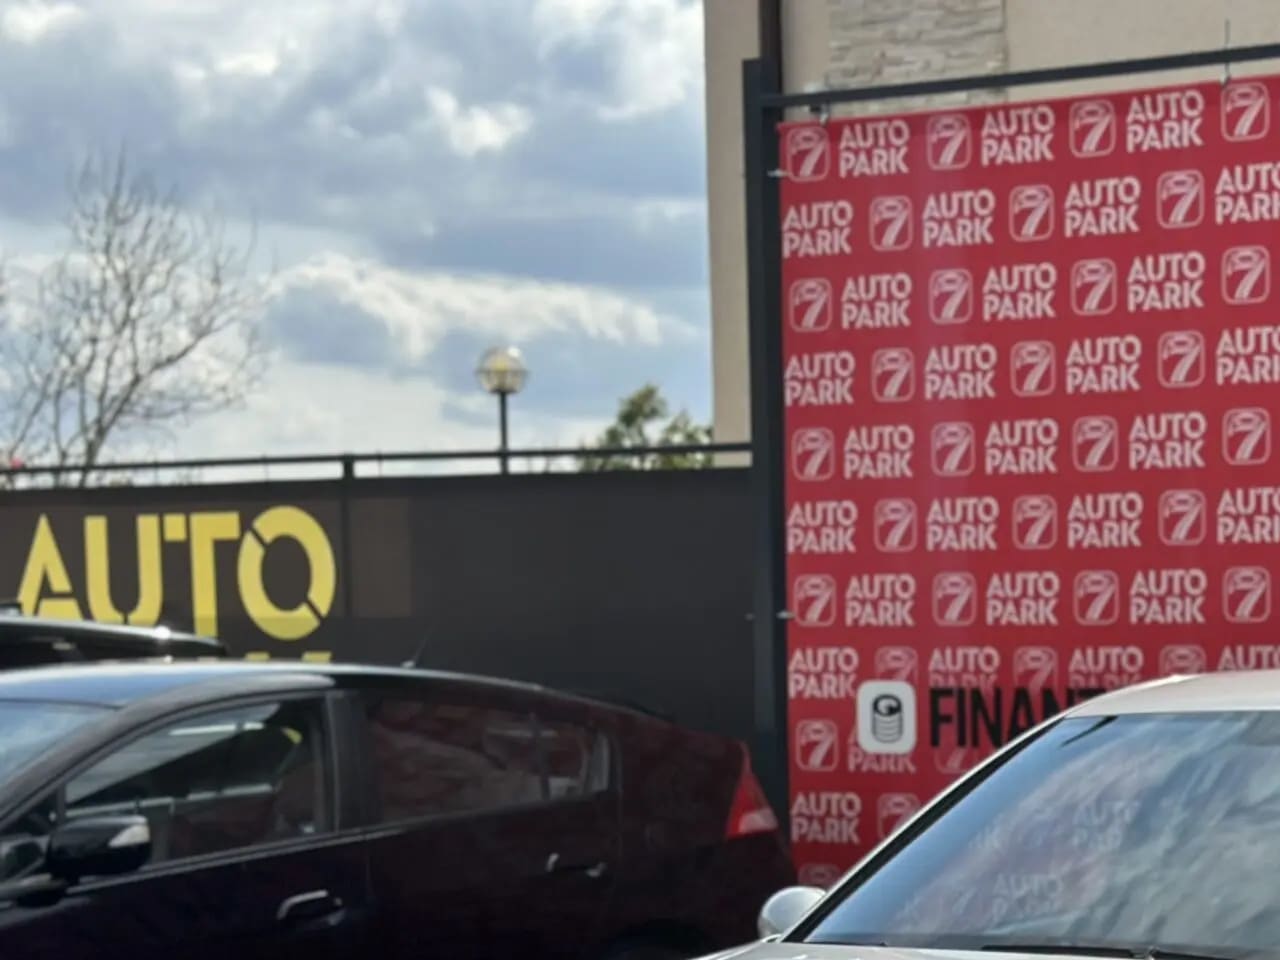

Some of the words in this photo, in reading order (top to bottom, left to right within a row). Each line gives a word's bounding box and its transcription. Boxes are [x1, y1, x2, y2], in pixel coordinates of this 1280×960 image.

[1127, 87, 1203, 121] AUTO
[838, 117, 908, 147] AUTO
[981, 102, 1054, 136] AUTO
[1127, 117, 1202, 152] PARK
[840, 146, 908, 177] PARK
[982, 133, 1053, 165] PARK
[923, 189, 995, 220] AUTO
[1065, 177, 1140, 209] AUTO
[783, 201, 852, 231] AUTO
[1065, 203, 1138, 237] PARK
[784, 227, 850, 257] PARK
[923, 216, 993, 247] PARK
[983, 263, 1056, 294] AUTO
[1128, 251, 1205, 283] AUTO
[842, 273, 912, 303] AUTO
[1128, 280, 1203, 312] PARK
[842, 300, 910, 328] PARK
[984, 290, 1054, 320] PARK
[925, 344, 996, 373] AUTO
[1067, 335, 1141, 366] AUTO
[785, 352, 854, 379] AUTO
[1067, 363, 1139, 393] PARK
[785, 378, 853, 405] PARK
[925, 371, 994, 399] PARK
[845, 425, 914, 452] AUTO
[986, 419, 1058, 447] AUTO
[1130, 412, 1206, 441] AUTO
[845, 450, 912, 478] PARK
[986, 446, 1056, 473] PARK
[1130, 439, 1204, 469] PARK
[788, 501, 857, 527] AUTO
[927, 497, 998, 525] AUTO
[1068, 493, 1142, 521] AUTO
[788, 527, 854, 552] PARK
[927, 524, 996, 550] PARK
[1068, 520, 1140, 547] PARK
[16, 506, 337, 640] AUTO
[846, 574, 915, 599] AUTO
[987, 572, 1059, 598] AUTO
[1131, 569, 1206, 595] AUTO
[846, 600, 912, 625] PARK
[987, 599, 1056, 624] PARK
[1131, 596, 1203, 622] PARK
[788, 647, 858, 673] AUTO
[929, 647, 999, 673] AUTO
[1069, 647, 1144, 672] AUTO
[789, 673, 858, 699] PARK
[792, 793, 860, 817] AUTO
[793, 818, 857, 842] PARK
